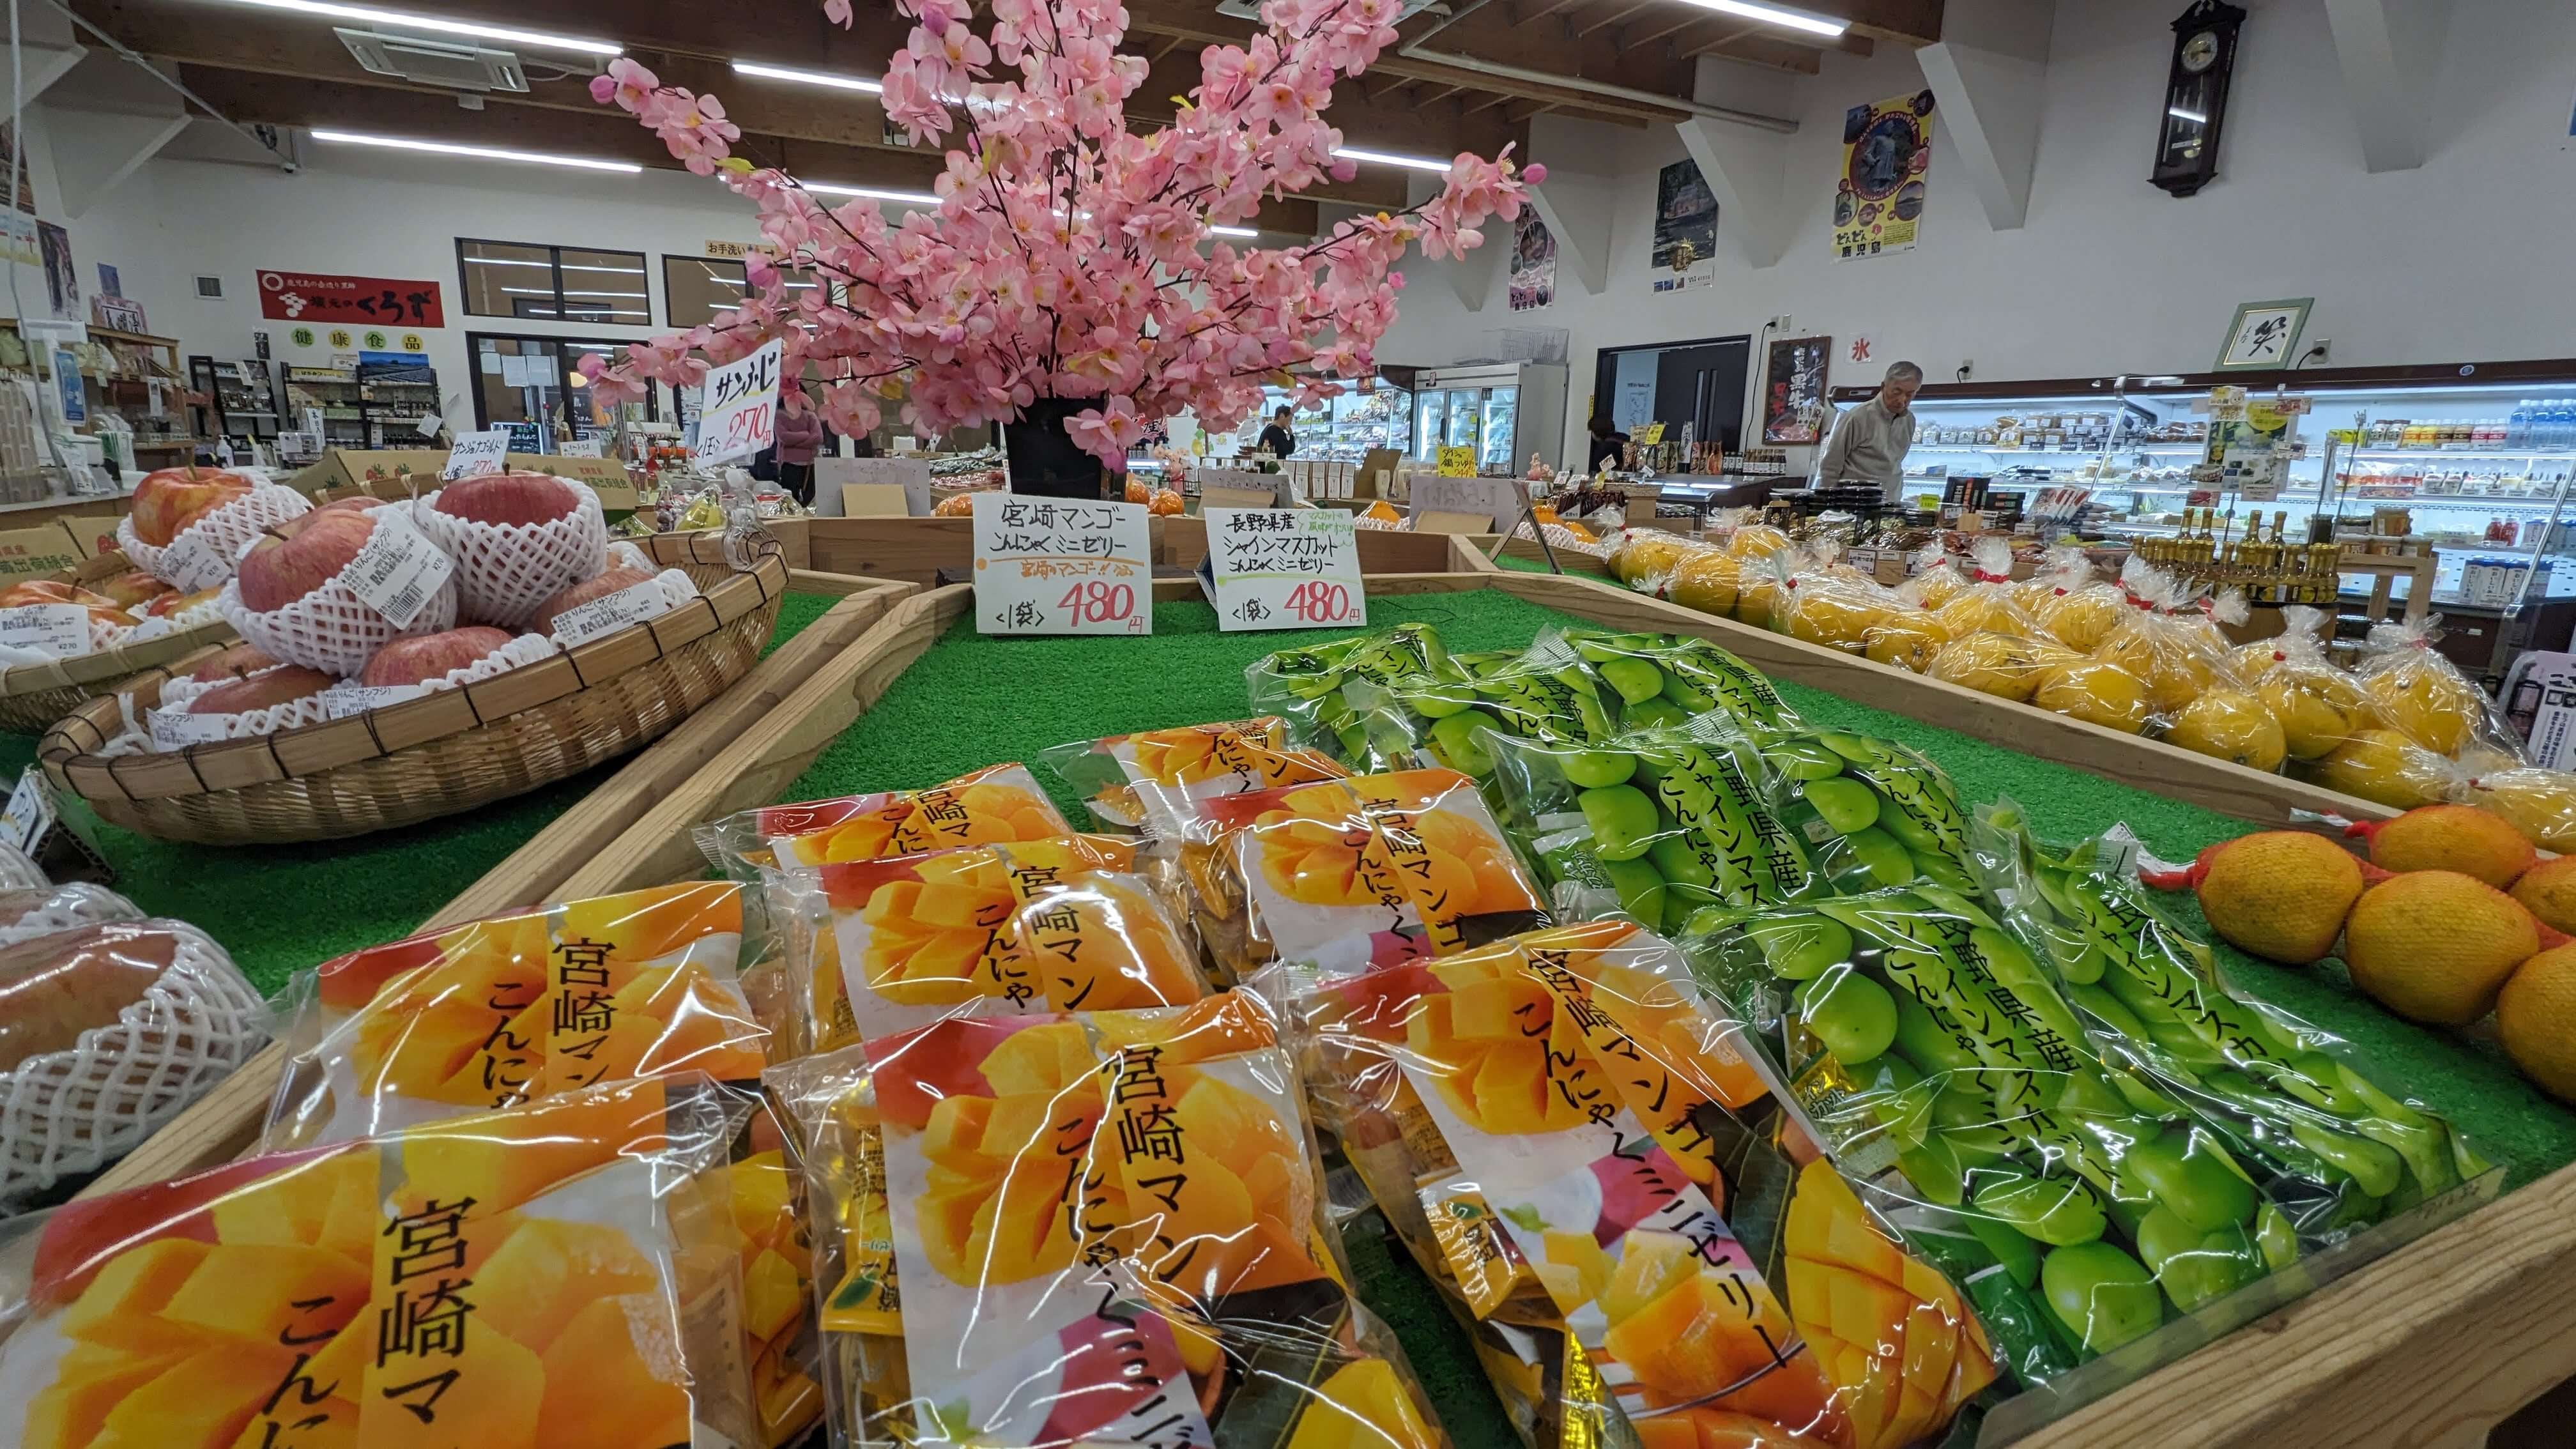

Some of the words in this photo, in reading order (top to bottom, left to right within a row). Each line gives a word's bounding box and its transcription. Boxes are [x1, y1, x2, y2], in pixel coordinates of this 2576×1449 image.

[709, 242, 746, 255] お手洗い
[1842, 241, 1881, 257] 鹿児島
[295, 328, 420, 350] 健康食品
[1852, 337, 1871, 362] 氷
[715, 351, 777, 409] サンふじ
[1001, 499, 1126, 530] 宮崎マンゴー
[1225, 511, 1296, 533] 長野県産
[989, 532, 1127, 558] こんにゃくミニゼリー
[1223, 534, 1338, 558] シャインマスカット
[1228, 556, 1335, 574] こんにゃくミニゼリー
[917, 785, 972, 847] 宮崎マ
[1011, 865, 1096, 1010] 宮崎マン
[975, 903, 1034, 1009] こんにゃ
[1528, 947, 1742, 1193] 宮崎マンゴー
[1105, 1044, 1202, 1282] 宮崎マン
[1512, 1000, 1788, 1368] こんにゃくミニゼリー
[376, 1195, 479, 1425] 宮崎マ
